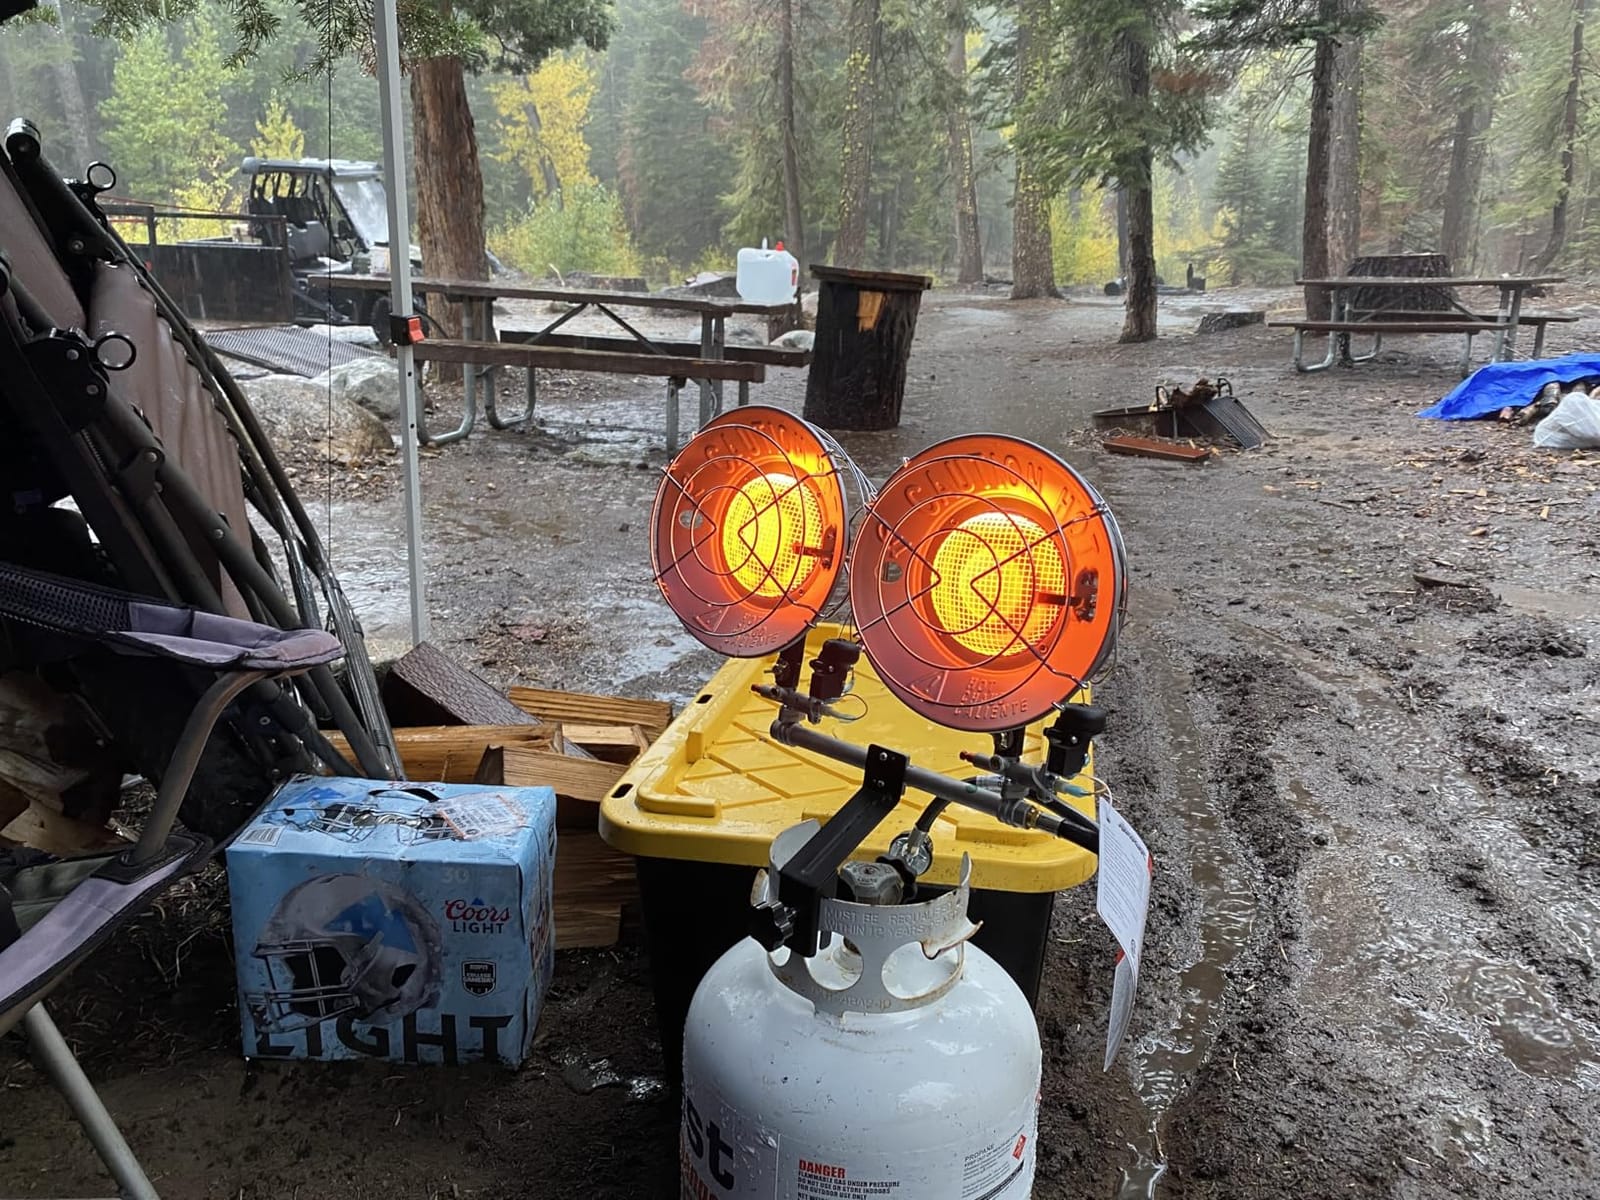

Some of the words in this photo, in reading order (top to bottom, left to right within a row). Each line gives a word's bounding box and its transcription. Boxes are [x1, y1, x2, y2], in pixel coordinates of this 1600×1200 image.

[904, 452, 1043, 516] CAUTION
[1055, 486, 1100, 555] HOT
[965, 676, 998, 693] HOT
[444, 899, 511, 923] Coors
[824, 905, 857, 921] MUST
[863, 912, 879, 924] BE
[453, 920, 505, 934] LIGHT
[255, 1012, 515, 1066] LIGHT
[799, 1159, 846, 1179] DANGER
[798, 1170, 833, 1185] FLAMMABLE
[834, 1178, 847, 1186] GAS
[848, 1180, 868, 1188] UNDER
[869, 1180, 900, 1188] PRESSURE
[807, 1178, 819, 1187] NOT
[820, 1181, 831, 1190] USE
[832, 1183, 841, 1191] OR
[842, 1185, 862, 1194] STORE
[798, 1182, 809, 1191] FOR
[810, 1186, 838, 1197] OUTDOOR
[839, 1191, 851, 1199] USE
